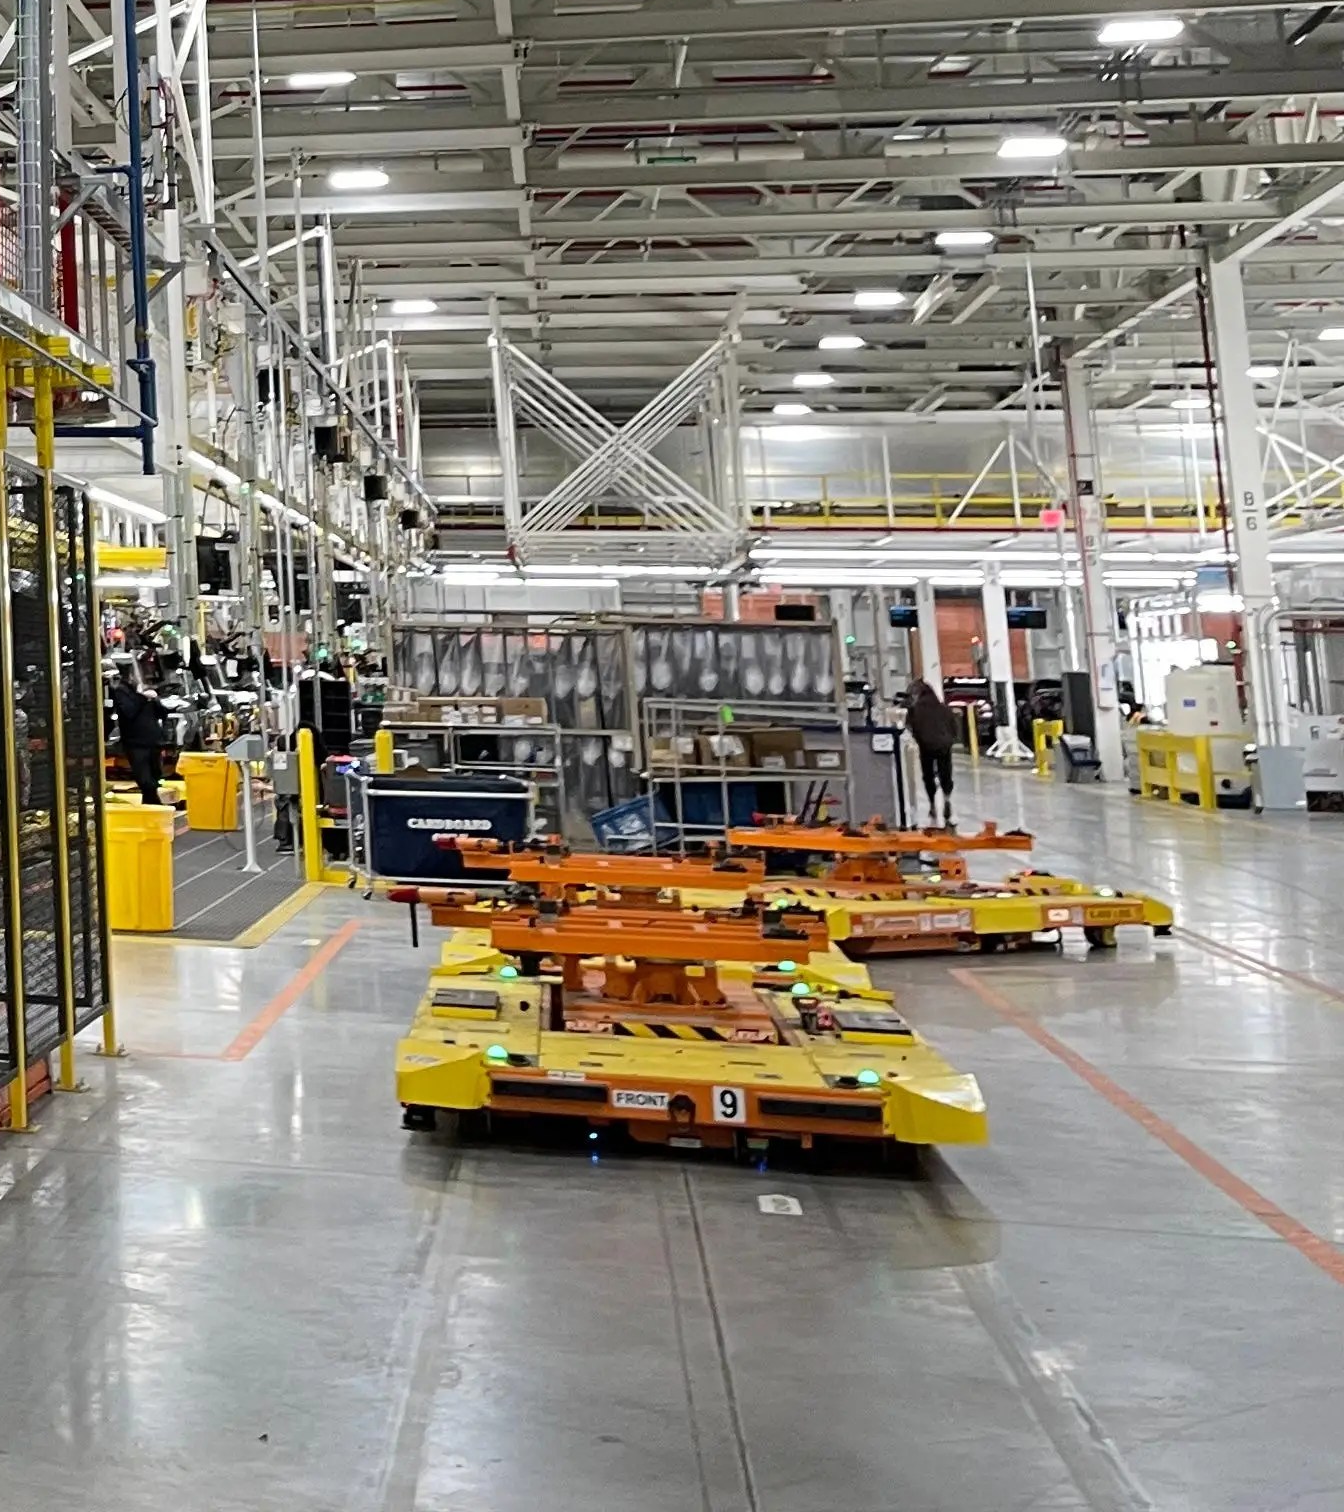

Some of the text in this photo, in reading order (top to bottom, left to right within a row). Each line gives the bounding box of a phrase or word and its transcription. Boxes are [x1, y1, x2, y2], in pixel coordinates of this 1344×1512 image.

[1246, 516, 1258, 531] 6
[616, 1093, 666, 1107] FRONT
[720, 1089, 737, 1119] 9
